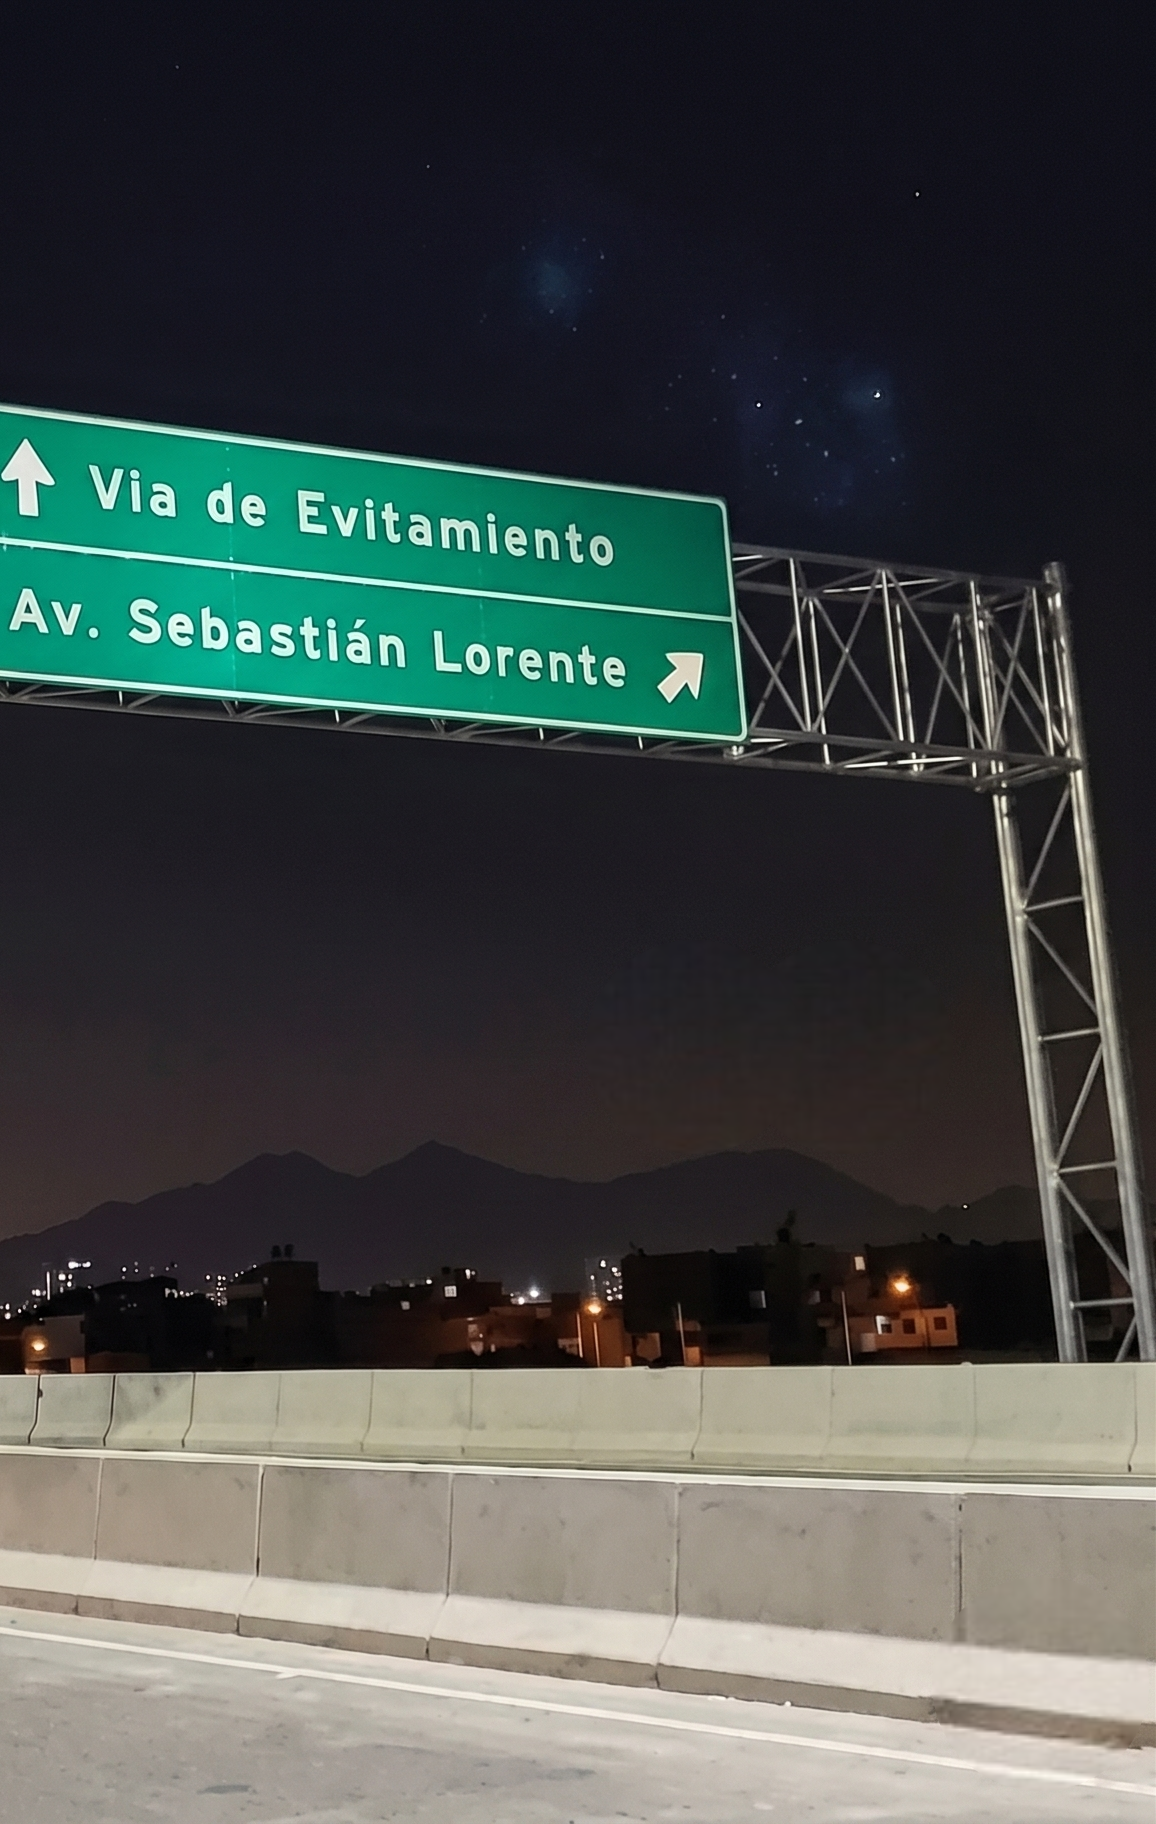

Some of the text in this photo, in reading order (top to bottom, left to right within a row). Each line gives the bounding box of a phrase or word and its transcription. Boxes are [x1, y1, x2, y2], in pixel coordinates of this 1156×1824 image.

[88, 463, 615, 567] Via de Evitamiento
[8, 587, 627, 688] Av. Sebastián Lorente
